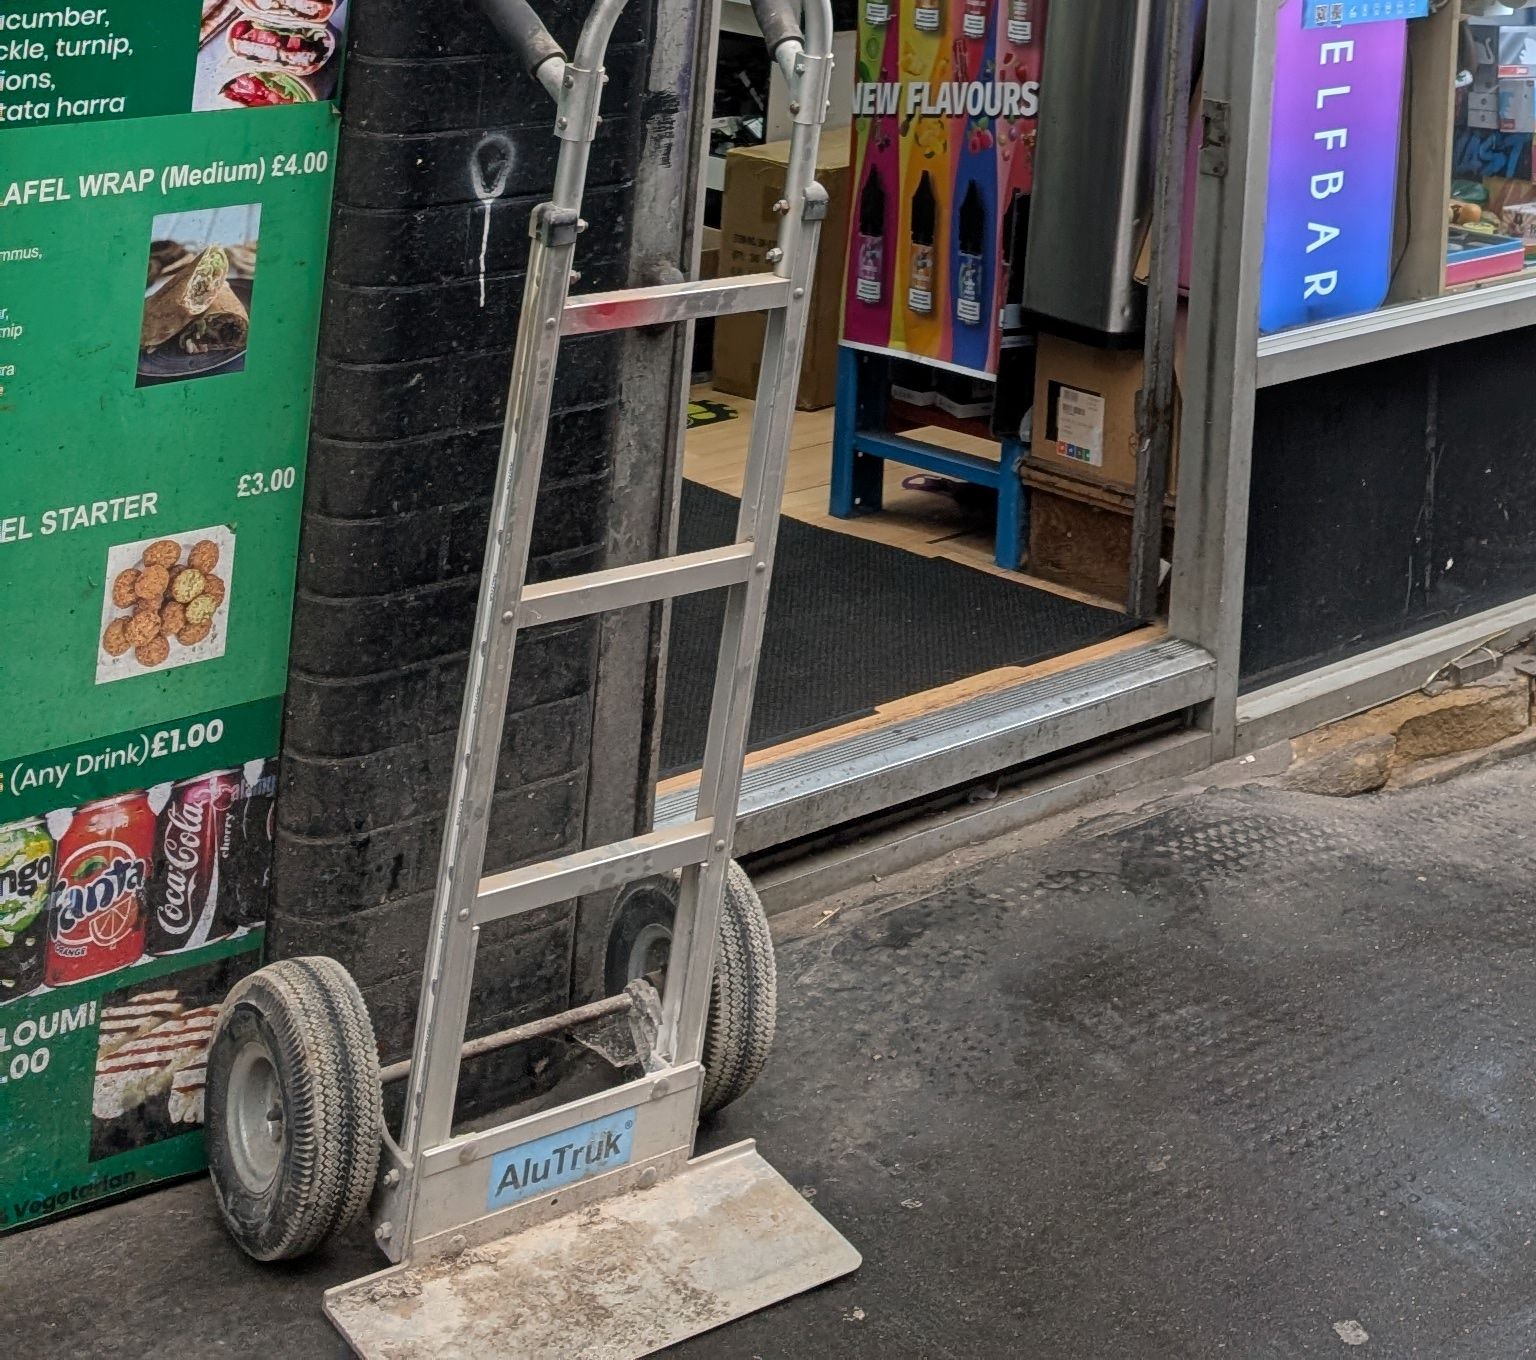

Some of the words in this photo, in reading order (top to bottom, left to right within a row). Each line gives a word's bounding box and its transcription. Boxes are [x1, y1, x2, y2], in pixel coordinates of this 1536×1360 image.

[55, 34, 133, 60] turnip,
[56, 94, 126, 118] harra
[852, 81, 902, 117] NEW
[906, 81, 1039, 118] FLAVOURS
[78, 168, 154, 199] WRAP
[161, 156, 267, 196] (Medium)
[271, 150, 328, 178] £4.00
[1303, 39, 1356, 299] ELFBAR
[237, 466, 296, 498] £3.00
[40, 492, 158, 535] STARTER
[10, 762, 71, 796] (Any
[221, 812, 237, 859] cherry
